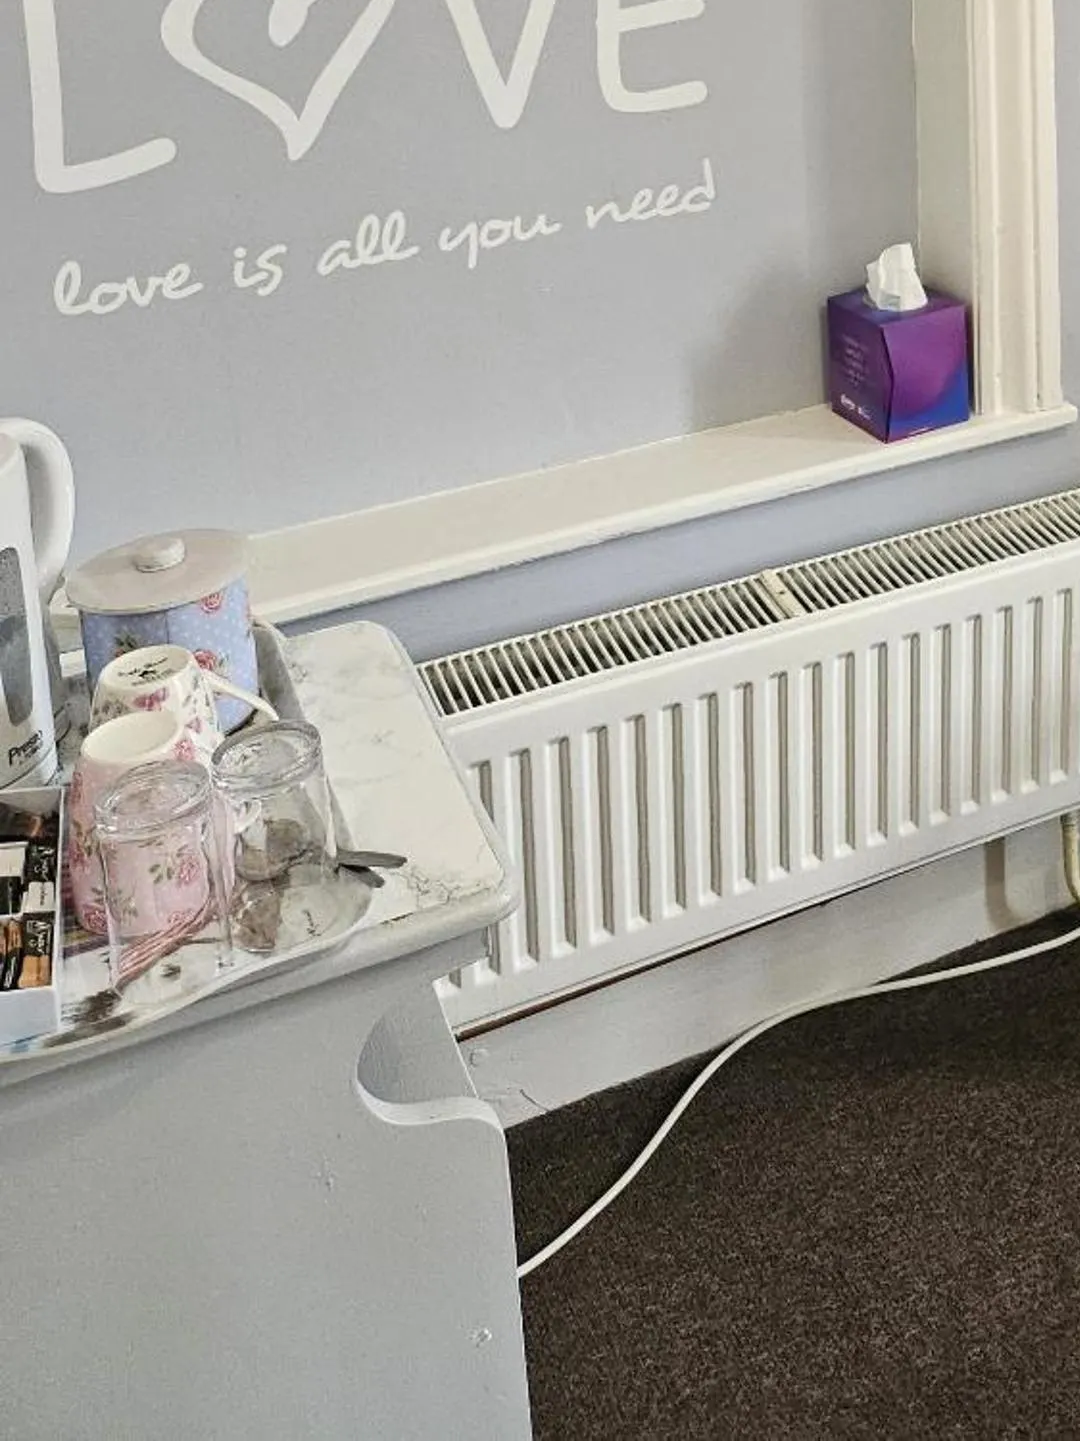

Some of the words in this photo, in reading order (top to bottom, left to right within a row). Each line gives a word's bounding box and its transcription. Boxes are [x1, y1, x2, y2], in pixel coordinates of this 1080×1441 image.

[54, 261, 203, 315] love
[234, 244, 287, 296] is
[317, 211, 419, 277] all
[439, 214, 562, 269] you
[586, 158, 715, 229] need
